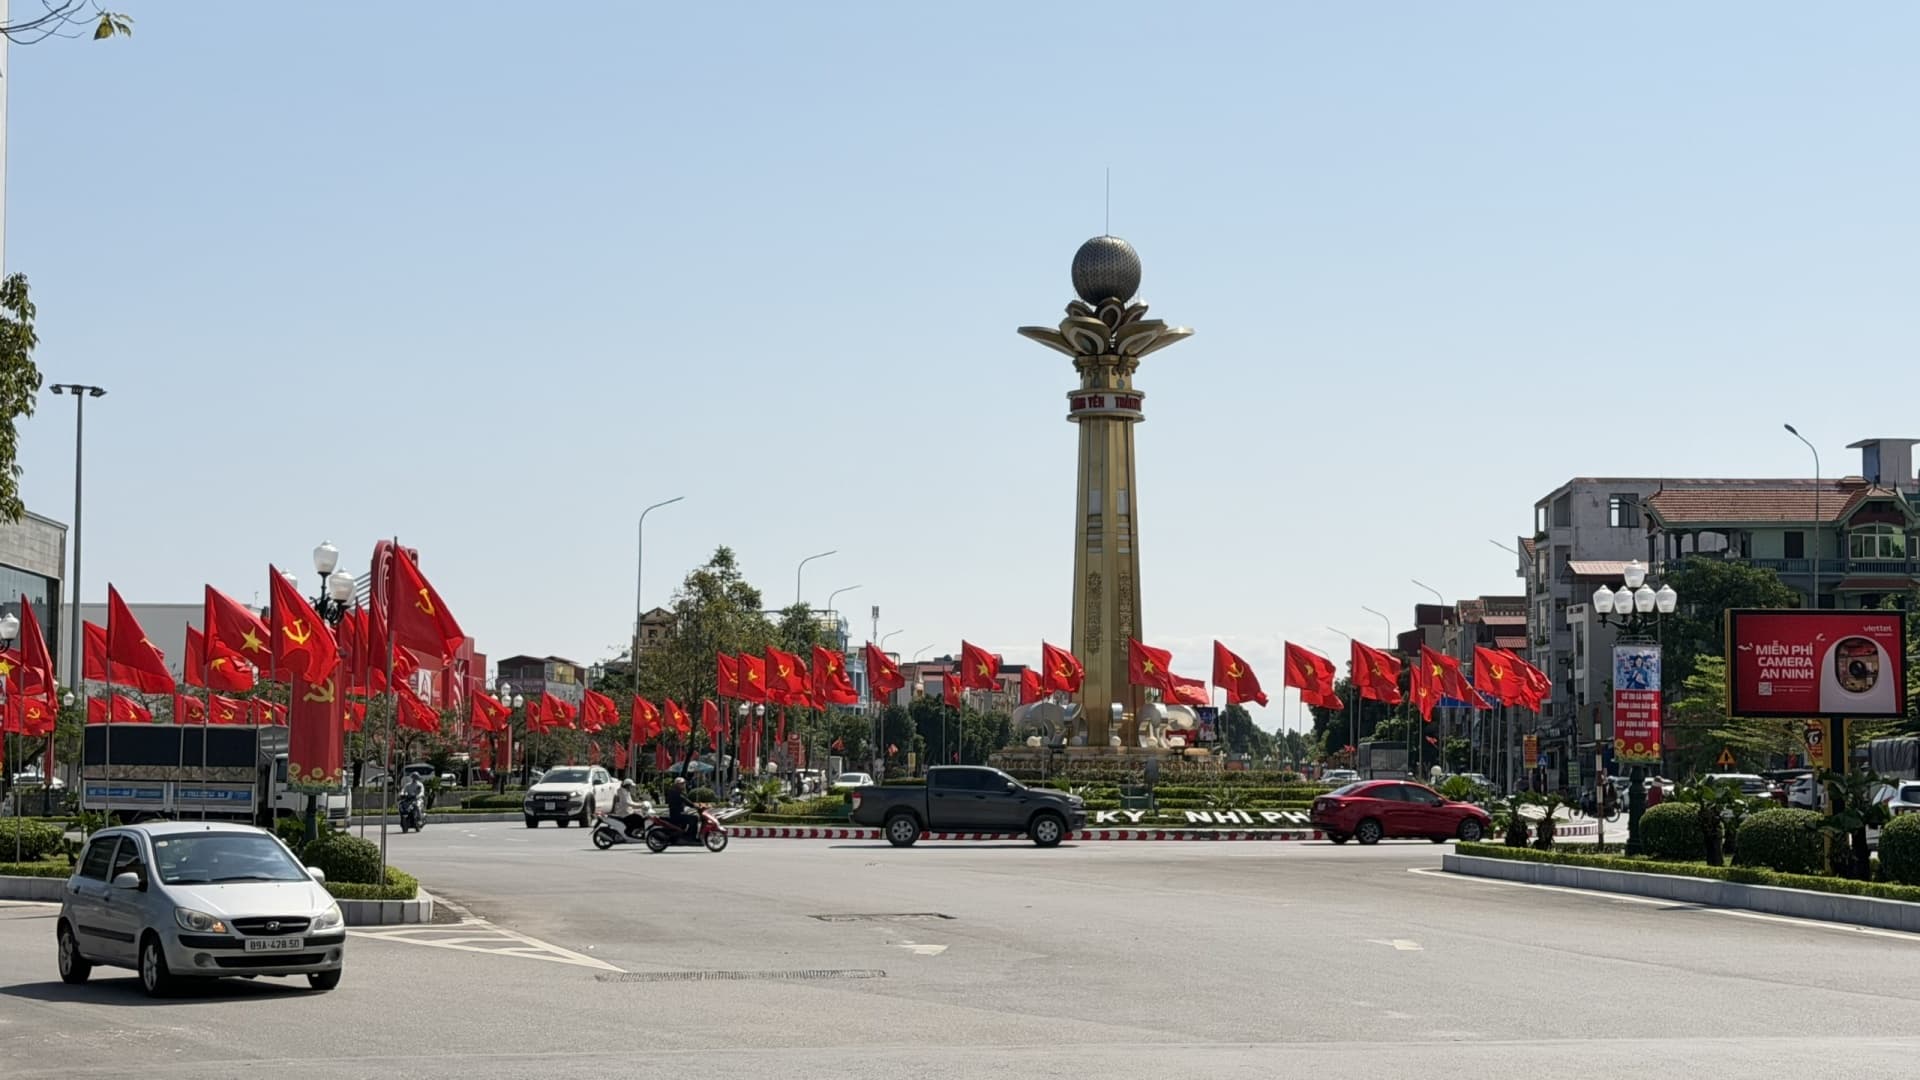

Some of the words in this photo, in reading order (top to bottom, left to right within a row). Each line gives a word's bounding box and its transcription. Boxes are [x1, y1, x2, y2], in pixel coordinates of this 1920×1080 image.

[1756, 640, 1789, 655] MIỄN
[1791, 642, 1813, 655] PHÍ
[1758, 656, 1813, 667] CAMERA
[1760, 668, 1779, 679] AN
[1782, 668, 1814, 679] NINH
[1260, 809, 1312, 823] PH
